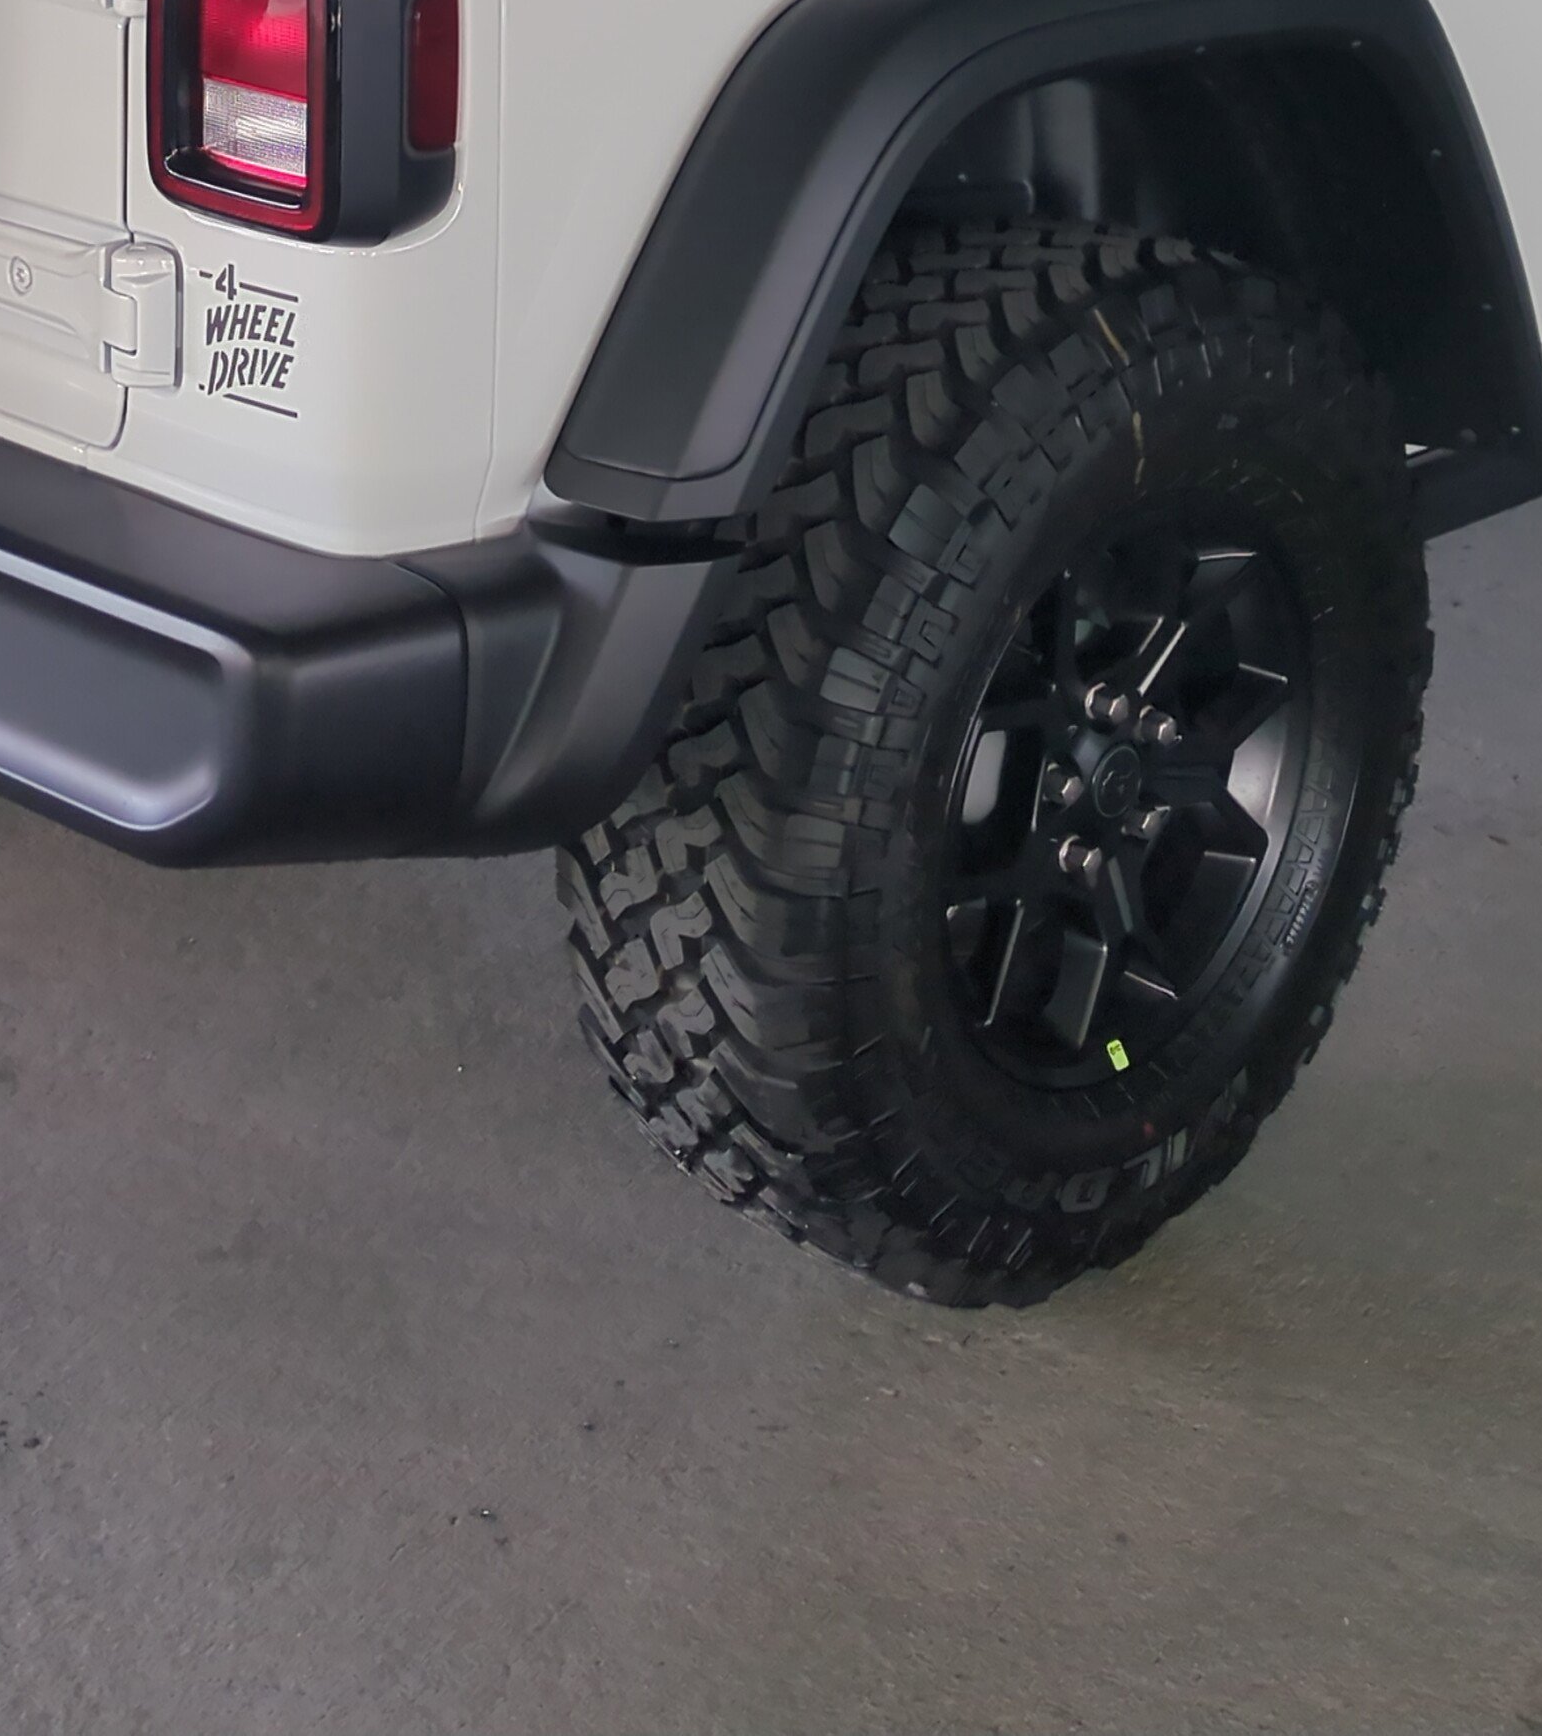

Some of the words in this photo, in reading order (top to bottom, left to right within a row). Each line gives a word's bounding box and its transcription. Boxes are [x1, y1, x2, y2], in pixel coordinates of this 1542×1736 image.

[215, 264, 237, 300] 4
[205, 304, 298, 348] WHEEL
[208, 348, 295, 395] DRIVE
